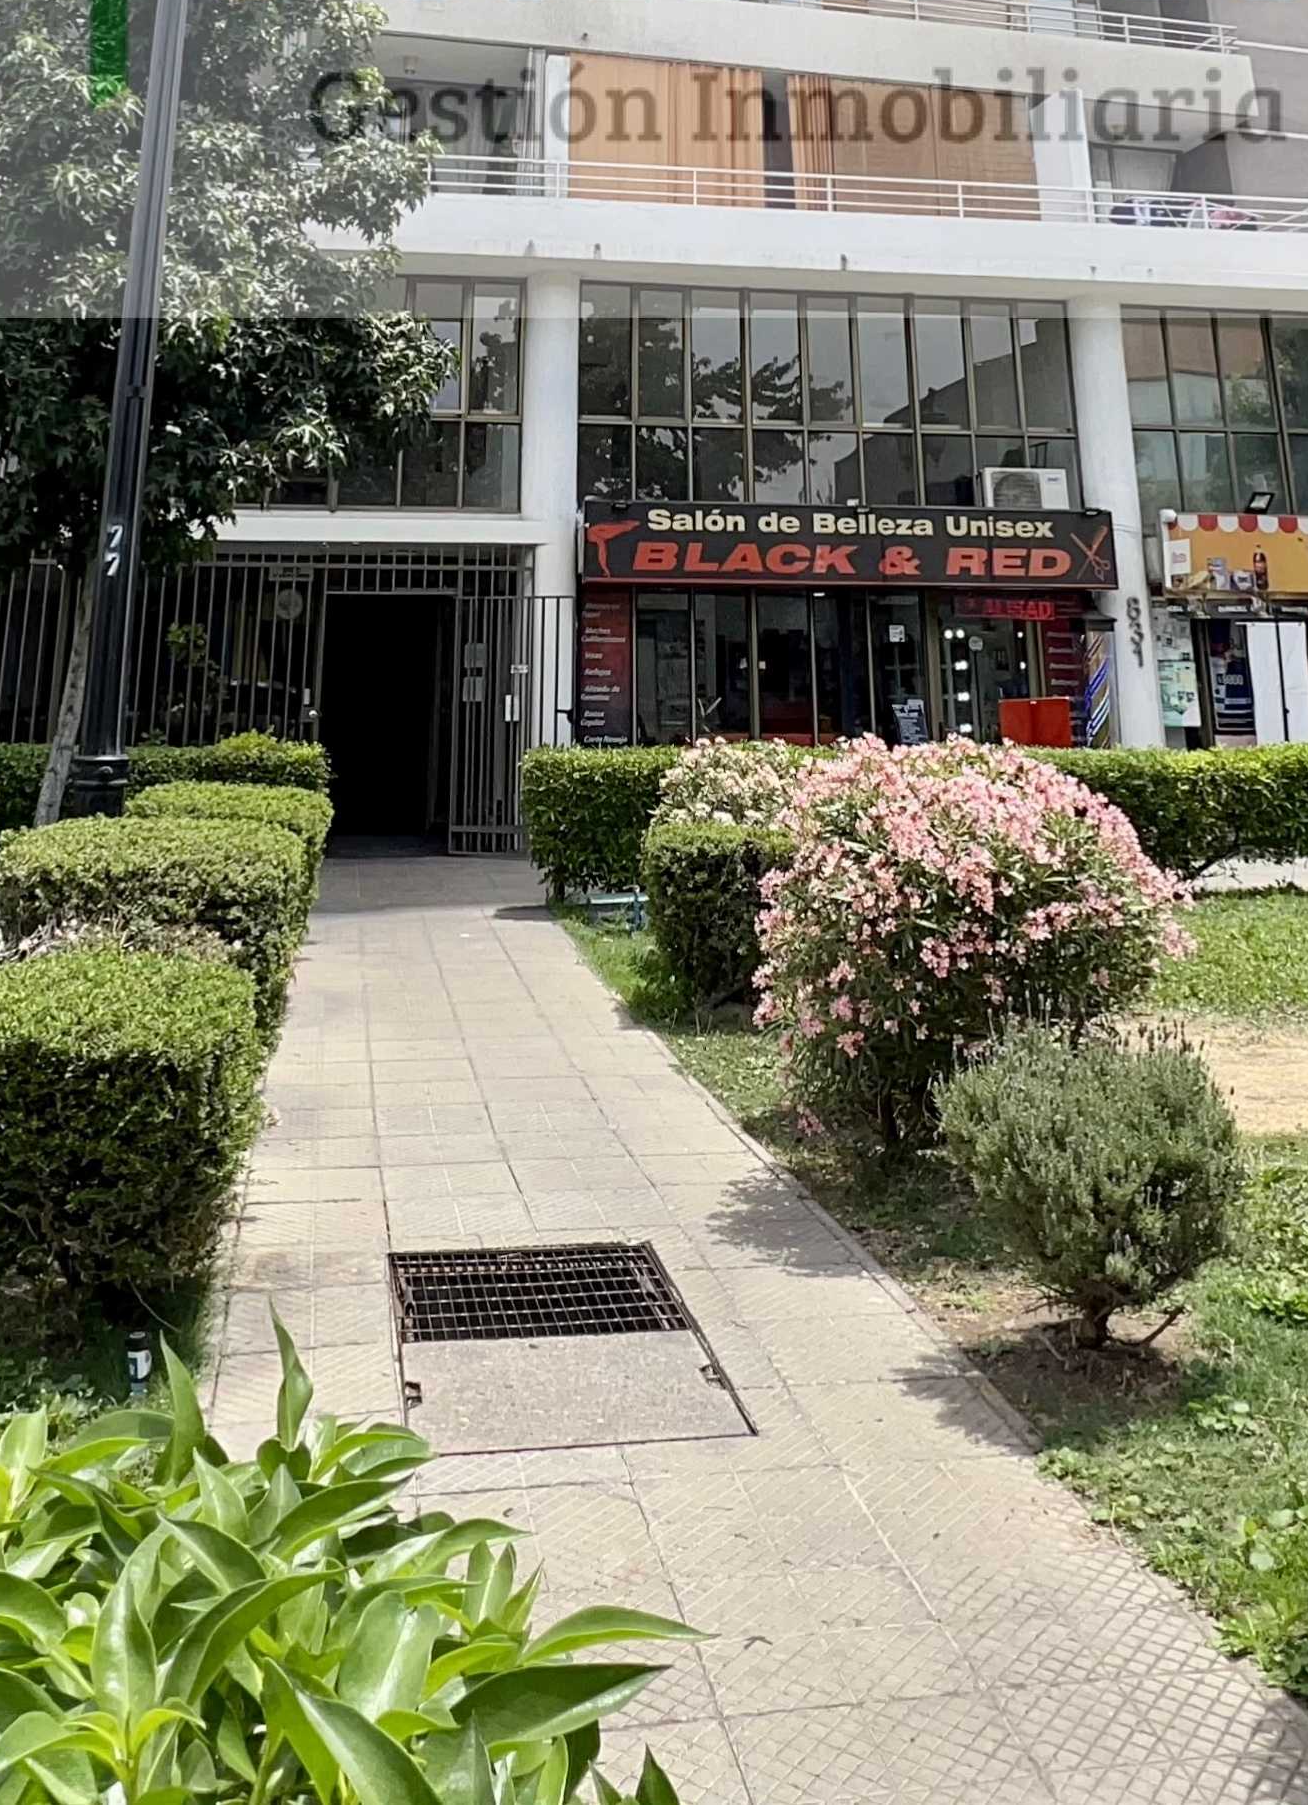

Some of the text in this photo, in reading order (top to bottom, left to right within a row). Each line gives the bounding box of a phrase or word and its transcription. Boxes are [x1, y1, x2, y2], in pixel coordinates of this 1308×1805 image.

[647, 509, 1054, 538] Salón de Belleza Unisex
[632, 542, 1071, 577] BLACK & RED
